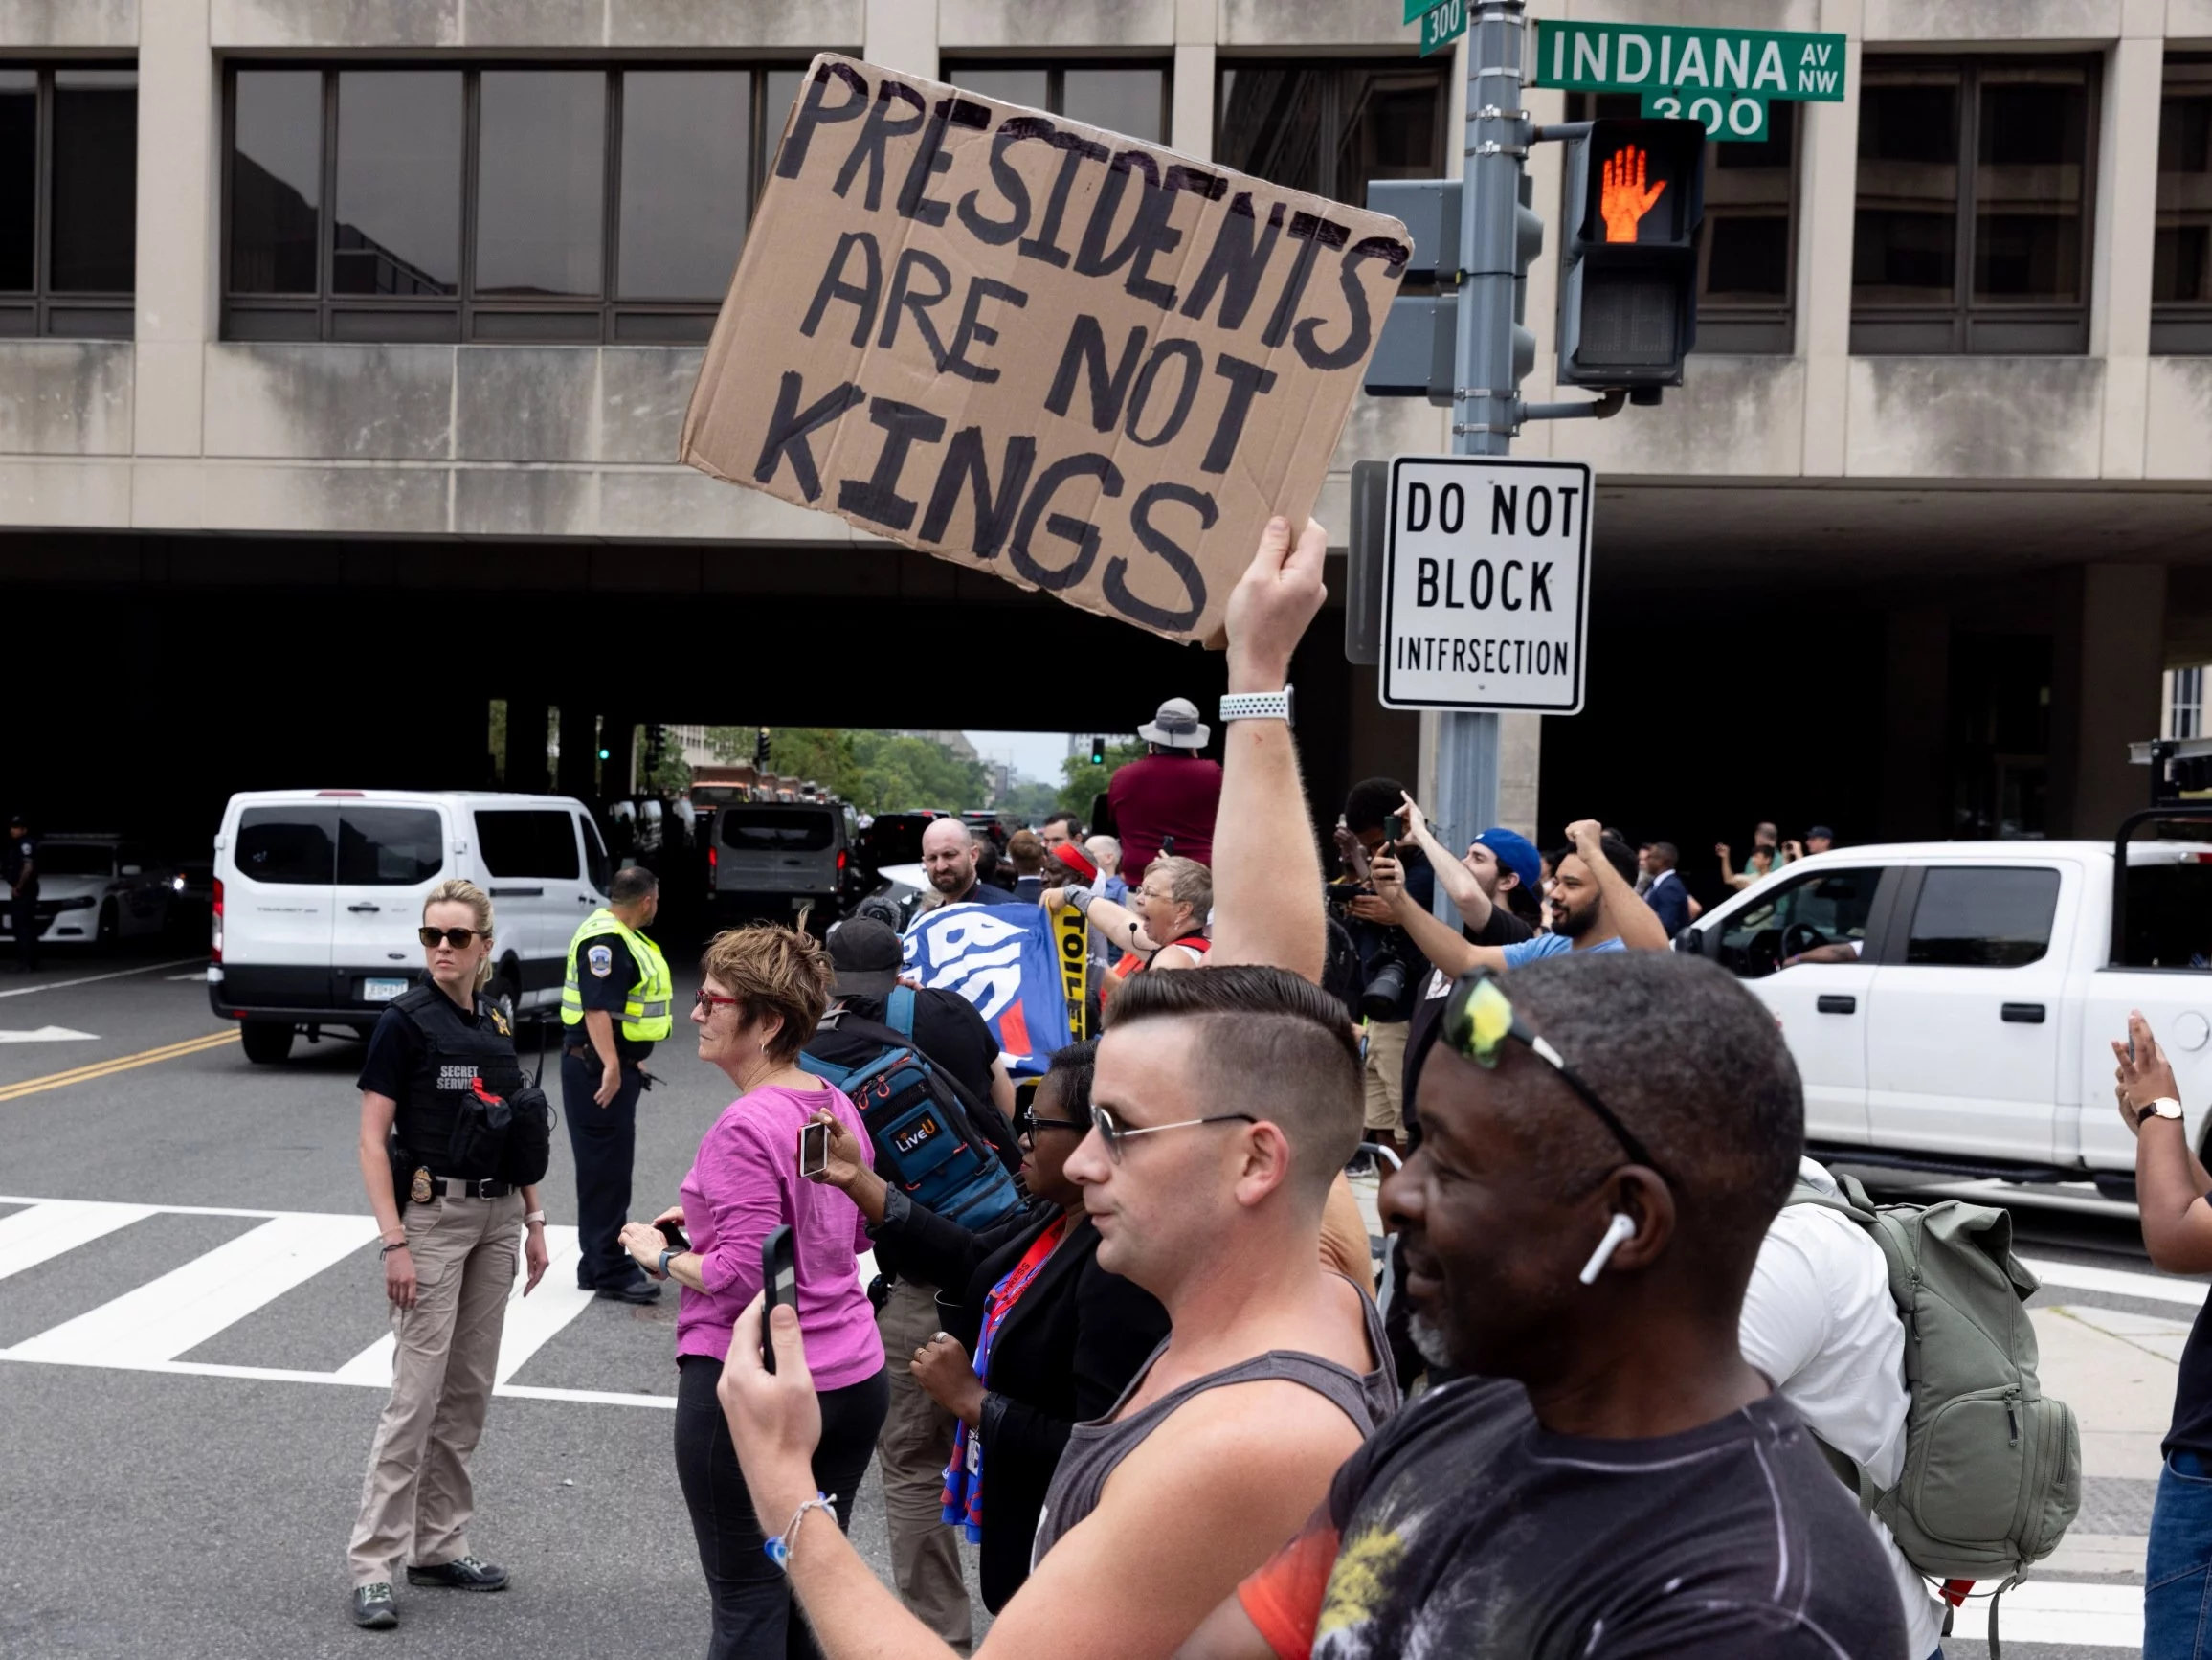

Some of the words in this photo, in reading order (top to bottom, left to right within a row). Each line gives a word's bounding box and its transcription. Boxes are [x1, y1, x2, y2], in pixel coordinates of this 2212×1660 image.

[1429, 0, 1460, 45] 300
[1553, 30, 1788, 91] INDIANA
[1799, 70, 1838, 93] NW
[1800, 43, 1832, 66] AV
[774, 61, 1413, 370] PRESIDENTS
[799, 231, 1028, 384] ARE
[1044, 313, 1277, 474] NOT
[753, 370, 1218, 632] KINGS
[1406, 482, 1465, 534] DO
[1491, 484, 1579, 537] NOT
[1416, 557, 1553, 612] BLOCK
[439, 1065, 479, 1078] SECRET
